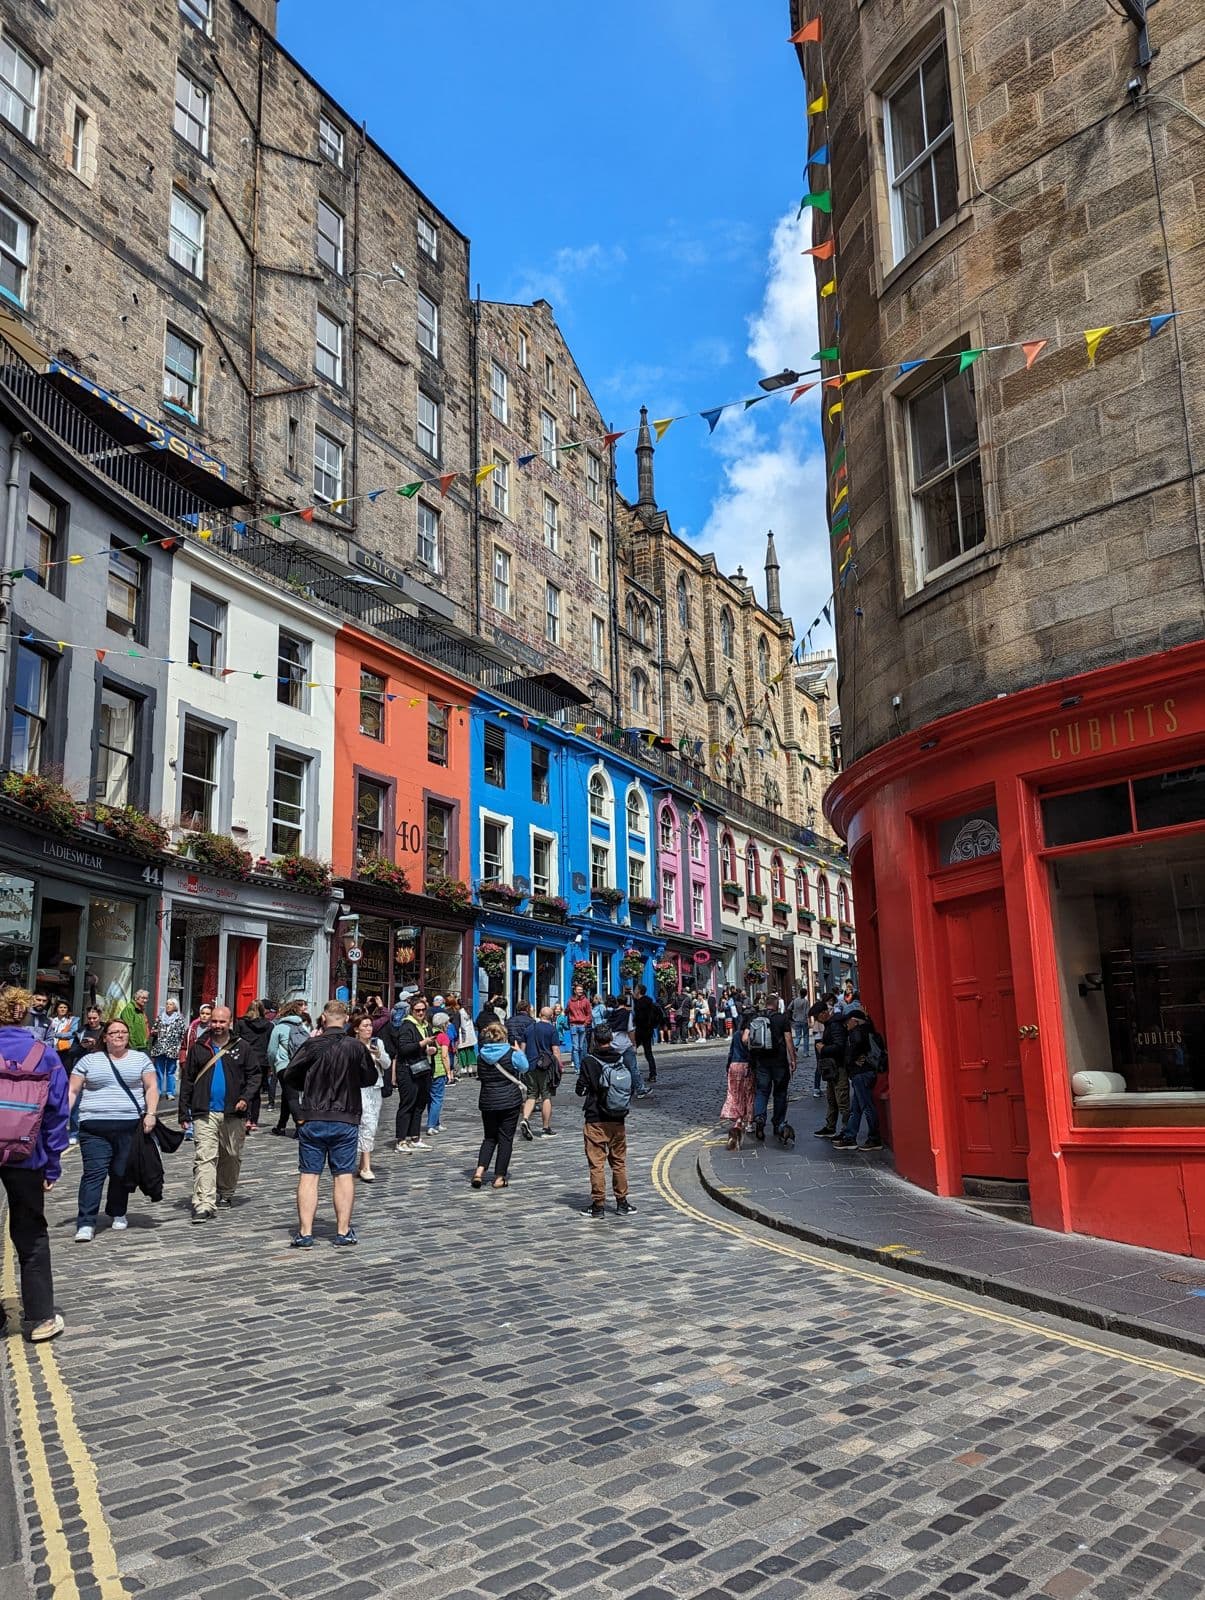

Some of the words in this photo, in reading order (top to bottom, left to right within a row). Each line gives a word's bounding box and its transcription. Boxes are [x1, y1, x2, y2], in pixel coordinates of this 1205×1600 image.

[1050, 699, 1178, 760] CUBITTS
[396, 821, 421, 854] 40
[43, 841, 103, 870] LADIESWEAR
[199, 883, 214, 894] door
[216, 887, 239, 900] gallery
[358, 957, 385, 971] USEUM
[1137, 1030, 1182, 1045] CUBITTS
